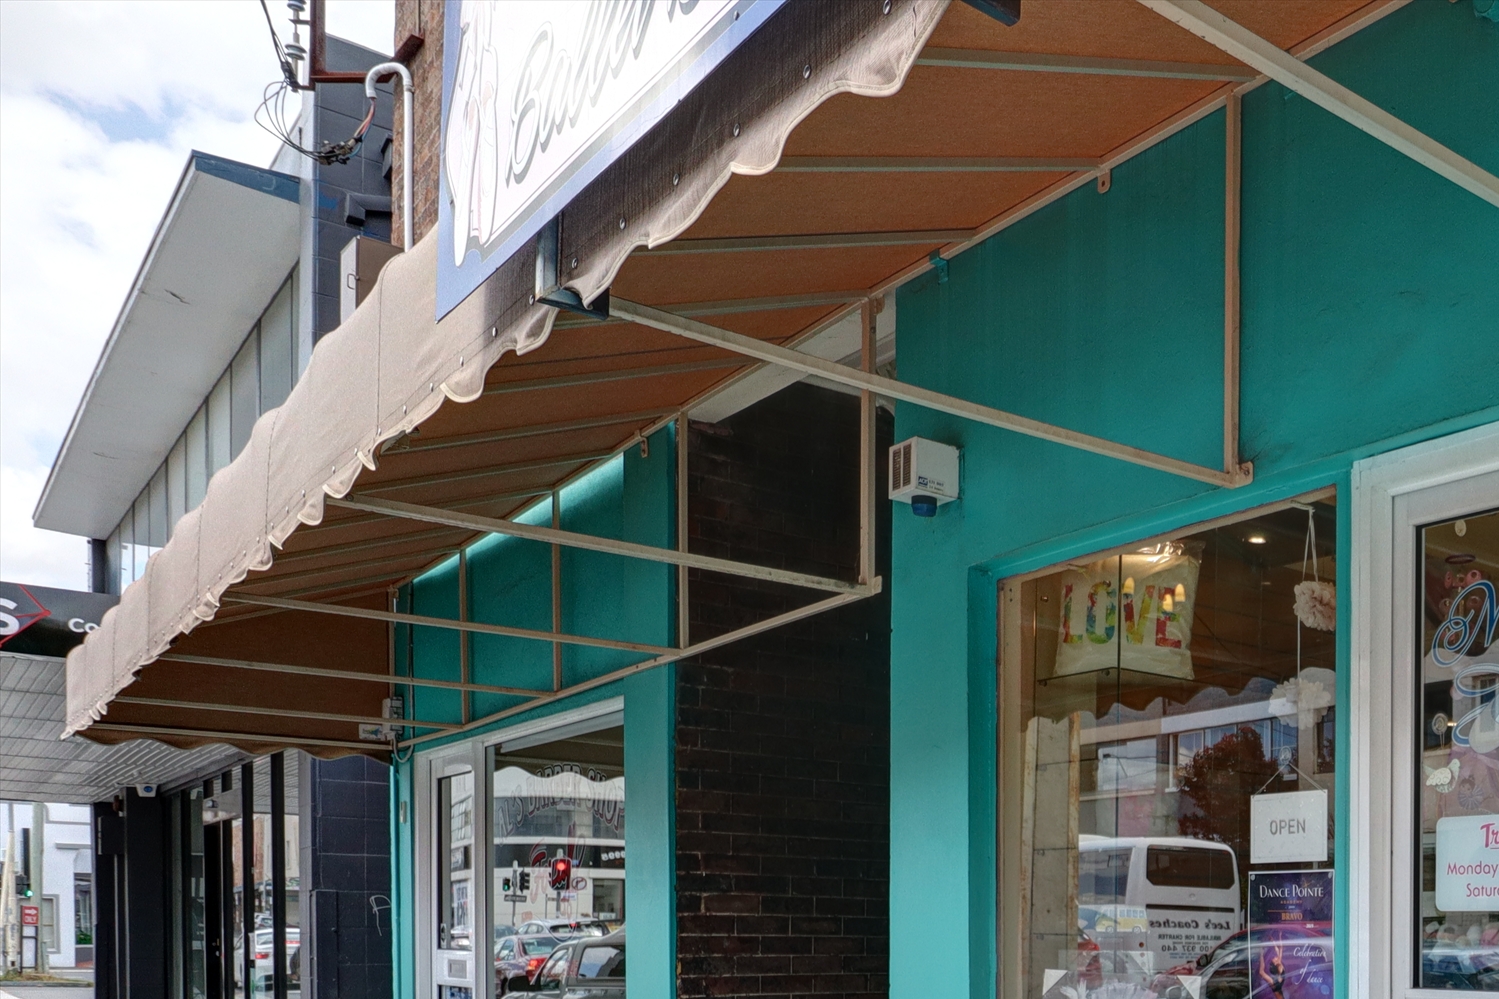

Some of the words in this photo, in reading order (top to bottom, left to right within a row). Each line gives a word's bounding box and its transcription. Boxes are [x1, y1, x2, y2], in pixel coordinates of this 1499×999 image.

[1063, 581, 1182, 649] LOVE
[526, 763, 583, 817] BARBER
[1269, 818, 1307, 836] OPEN
[1259, 884, 1290, 898] DANCE
[1292, 883, 1324, 898] POINTE
[1281, 912, 1303, 921] BRAVO
